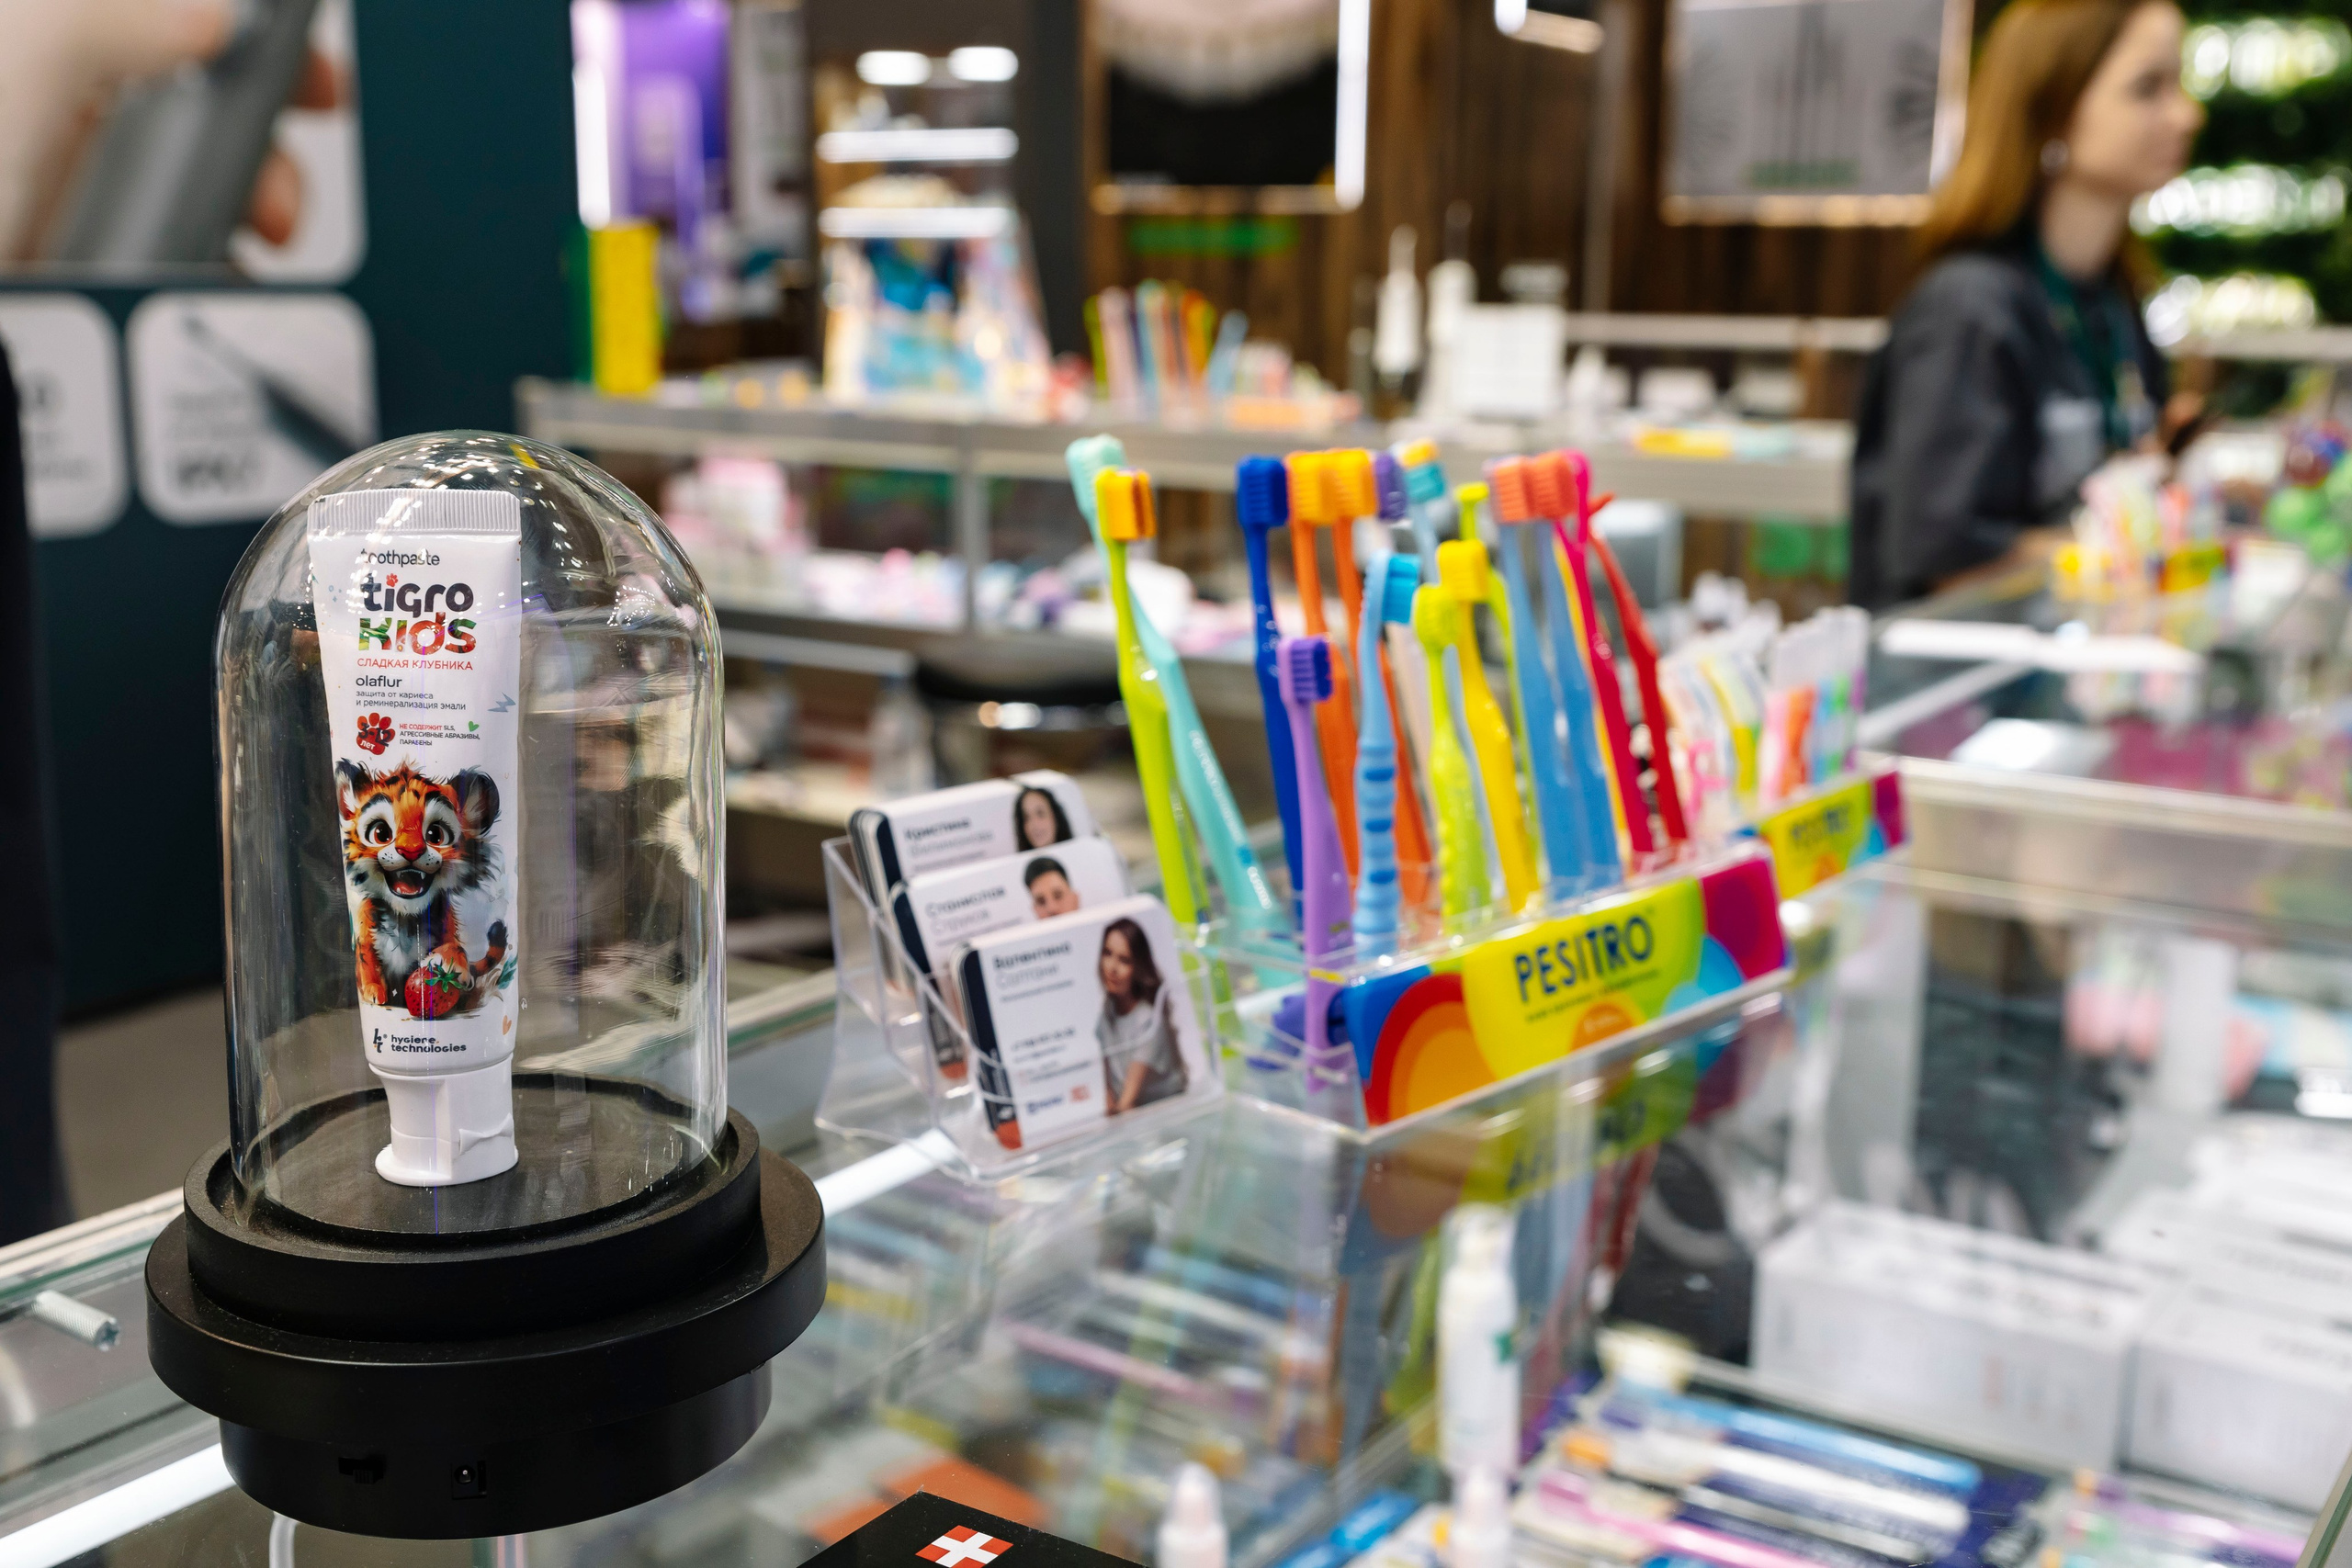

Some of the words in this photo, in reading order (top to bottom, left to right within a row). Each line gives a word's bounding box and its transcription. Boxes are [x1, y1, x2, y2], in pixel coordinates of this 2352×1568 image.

[360, 573, 474, 618] tigro
[357, 658, 409, 669] СЛАДКАЯ
[412, 660, 473, 671] КЛУБНИКА
[356, 675, 402, 688] olaflur
[356, 691, 386, 699] защита
[399, 692, 434, 700] кариеса
[363, 700, 438, 709] реминерализация
[360, 739, 376, 750] лет
[1514, 916, 1654, 1002] PESITRO
[391, 1043, 467, 1053] technologies
